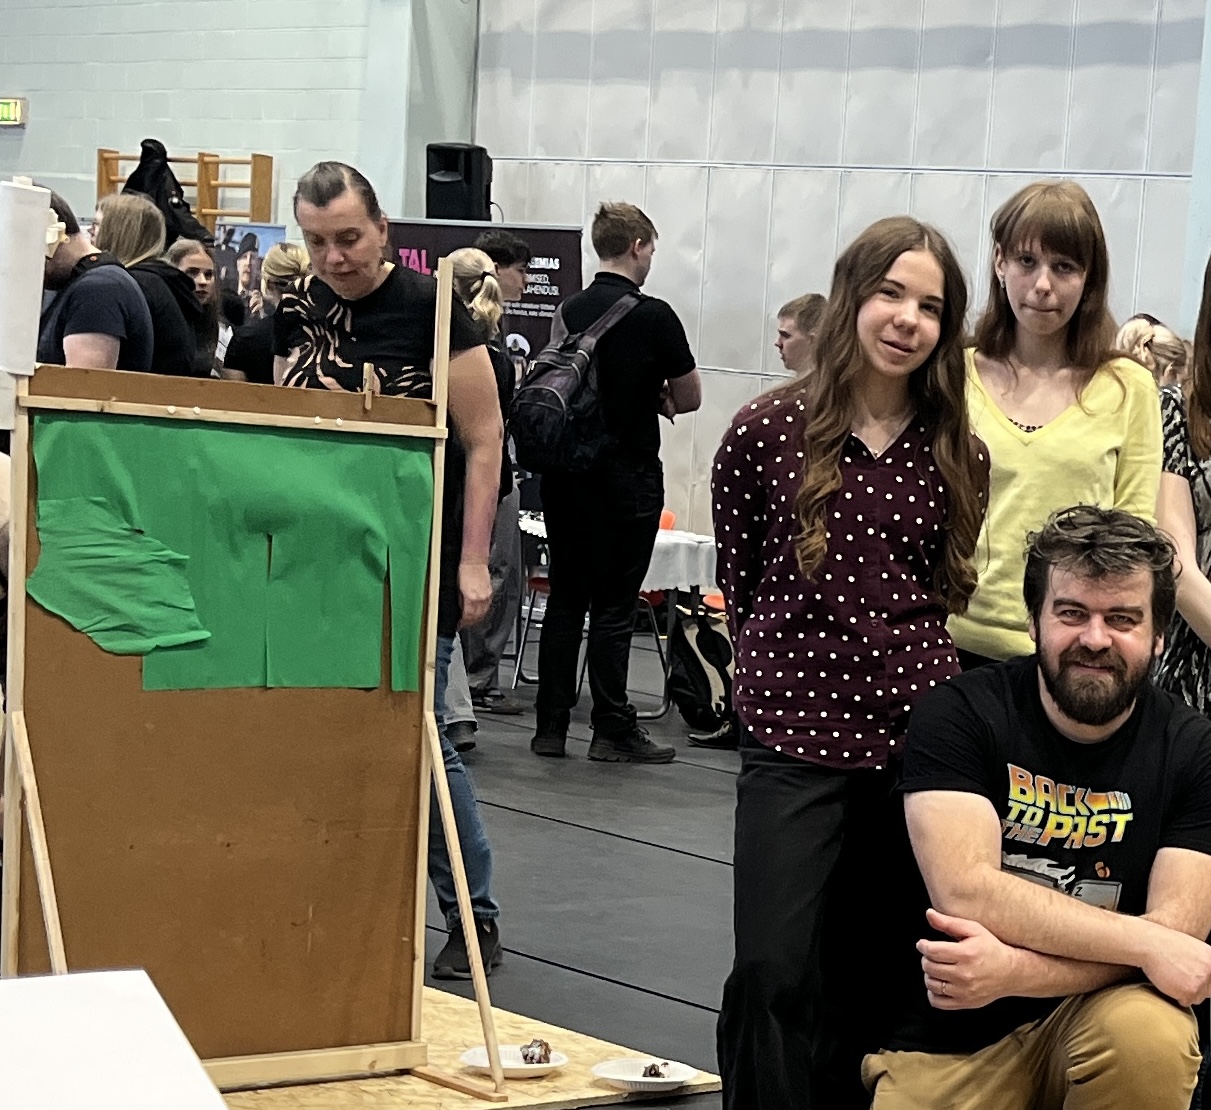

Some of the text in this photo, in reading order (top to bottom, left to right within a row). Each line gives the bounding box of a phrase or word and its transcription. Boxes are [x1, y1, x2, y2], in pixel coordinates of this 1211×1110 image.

[1007, 763, 1091, 816] BACK
[1001, 812, 1134, 849] THE PAST
[1006, 800, 1045, 827] TO
